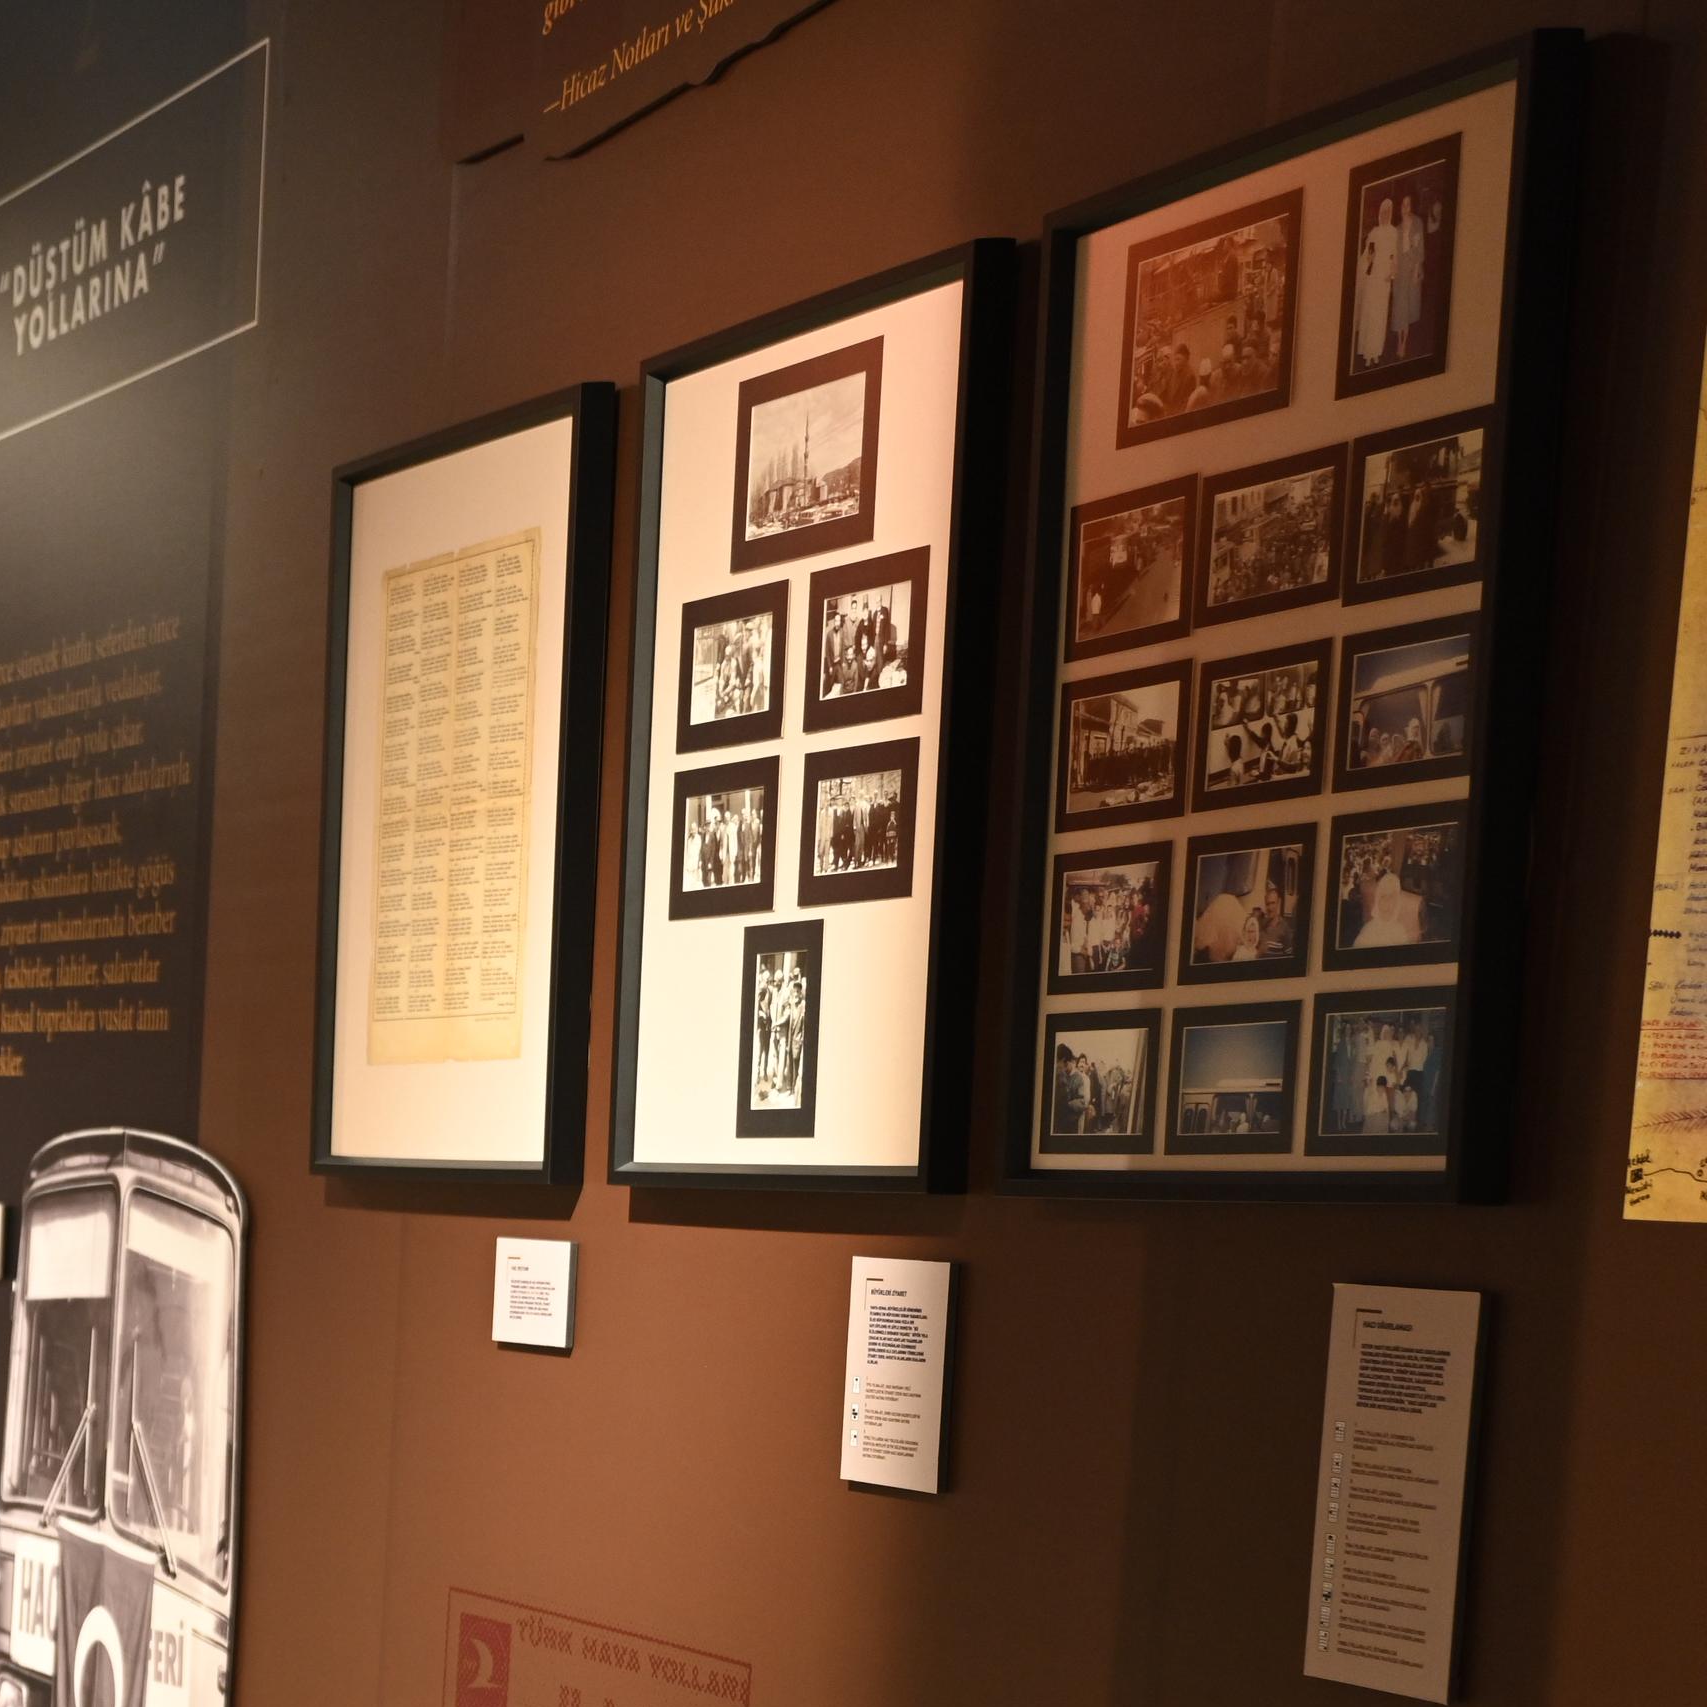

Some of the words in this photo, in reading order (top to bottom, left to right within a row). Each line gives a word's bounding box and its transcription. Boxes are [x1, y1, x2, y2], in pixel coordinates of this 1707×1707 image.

[609, 22, 671, 81] Notları
[674, 7, 694, 41] ve
[119, 174, 188, 249] KÂBE
[515, 1615, 573, 1656] TÜRK
[582, 1635, 641, 1675] HAVA
